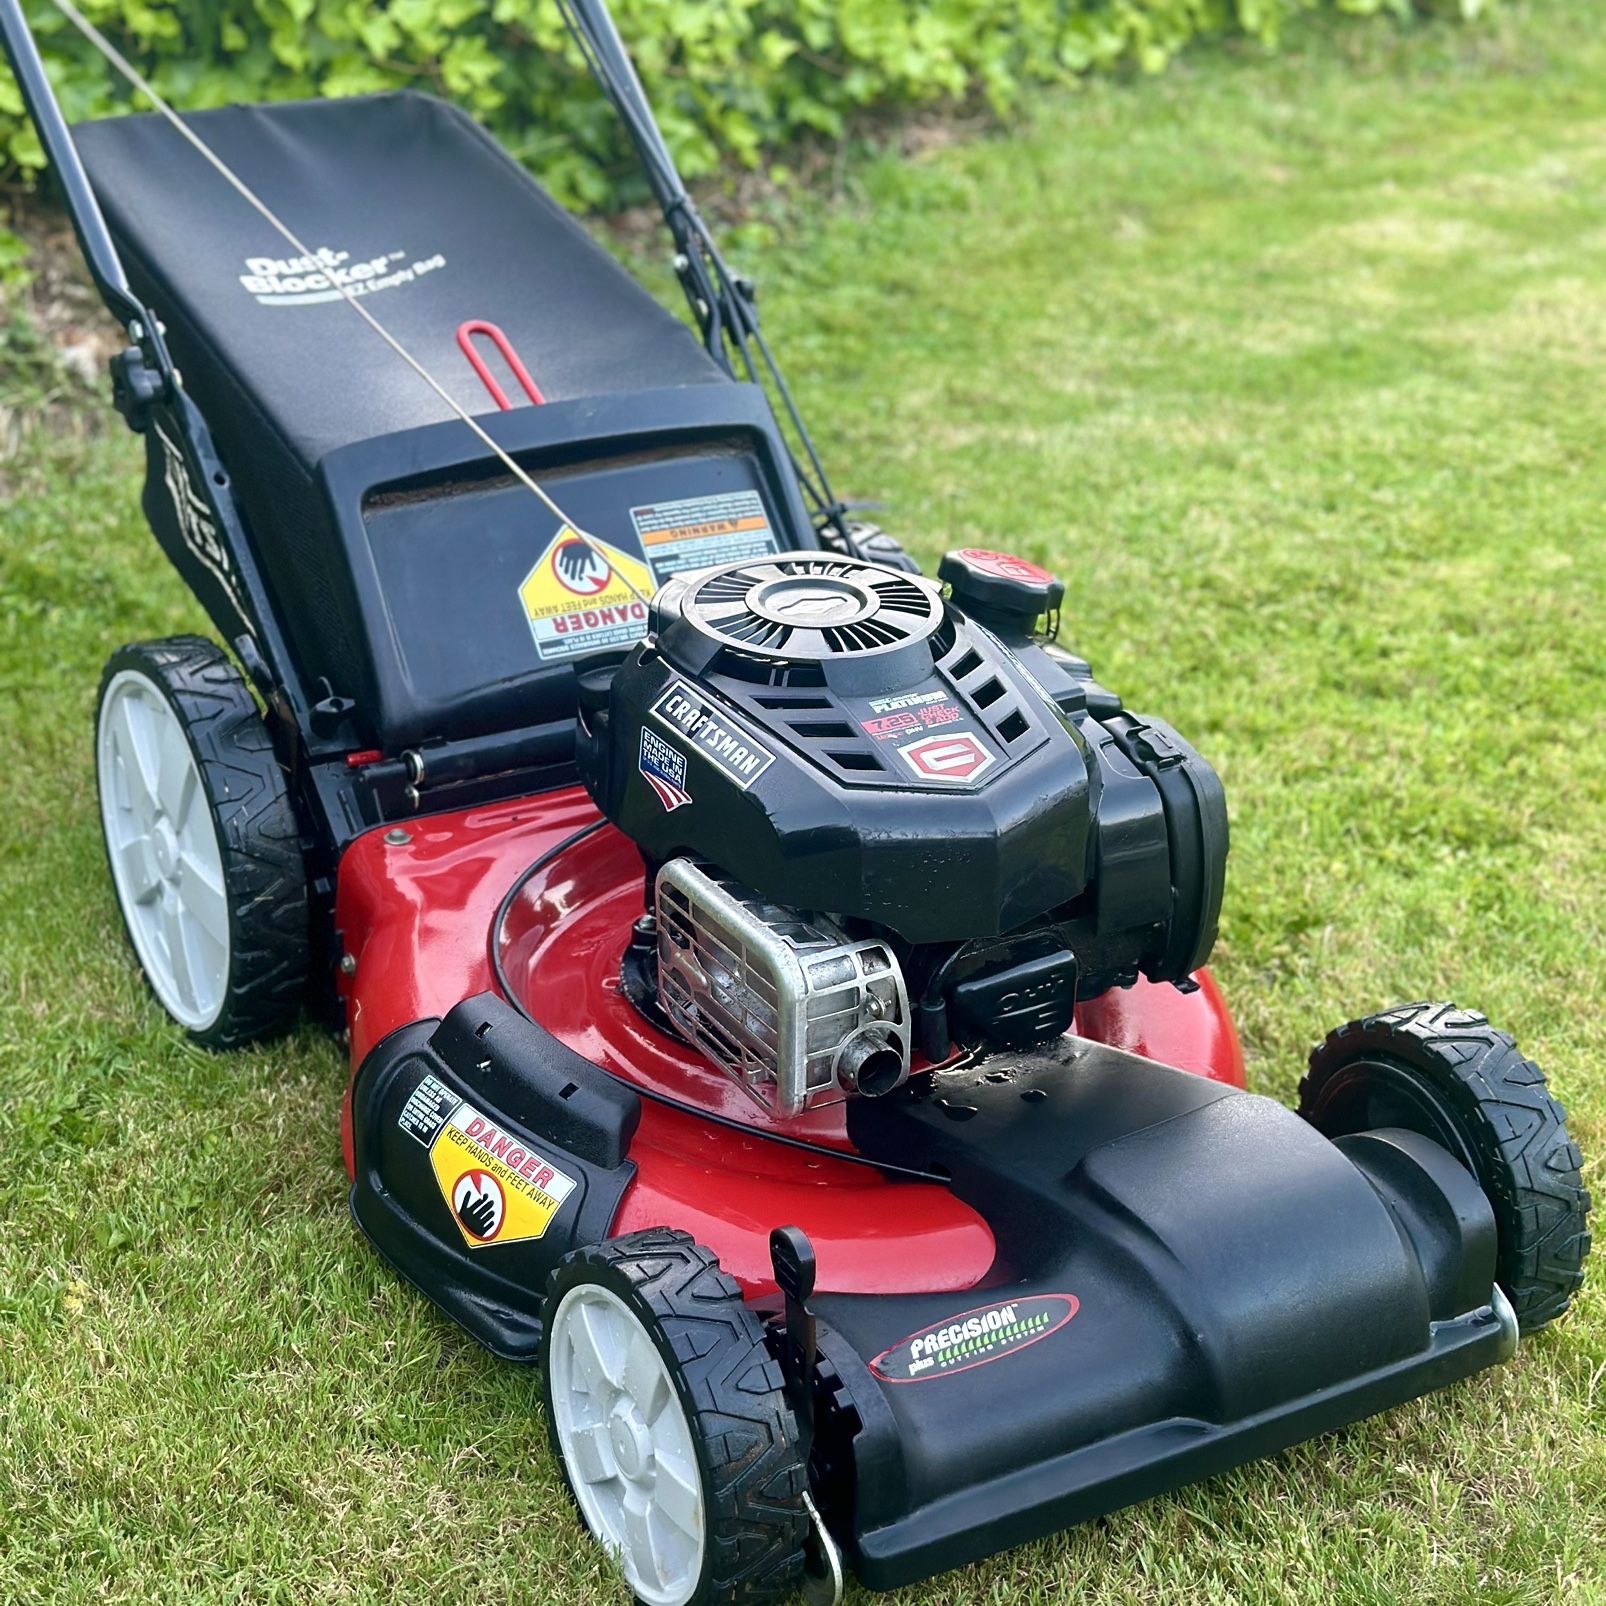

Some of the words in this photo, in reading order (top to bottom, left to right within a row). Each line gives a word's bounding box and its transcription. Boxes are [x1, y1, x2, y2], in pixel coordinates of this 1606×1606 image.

[670, 521, 727, 539] WARNING
[534, 603, 559, 617] AWAY
[561, 600, 582, 612] FEET
[584, 597, 598, 608] and
[600, 592, 628, 603] HANDS
[552, 602, 646, 634] DANGER
[872, 714, 915, 730] 7.25
[919, 703, 945, 714] JUST
[644, 730, 684, 766] ENGINE
[665, 695, 761, 775] CRAFTSMAN
[643, 740, 671, 766] MADE
[672, 762, 683, 776] IN
[643, 747, 661, 767] THE
[661, 765, 683, 785] USA
[446, 1127, 468, 1147] KEEP
[465, 1141, 494, 1168] HANDS
[491, 1163, 507, 1178] and
[505, 1173, 529, 1193] FEET
[526, 1188, 556, 1211] AWAY
[465, 1117, 555, 1190] DANGER
[910, 1306, 1017, 1359] PRECISION
[908, 1356, 934, 1376] plus
[940, 1344, 994, 1368] CUTTING
[1000, 1325, 1045, 1345] SYSTEM
